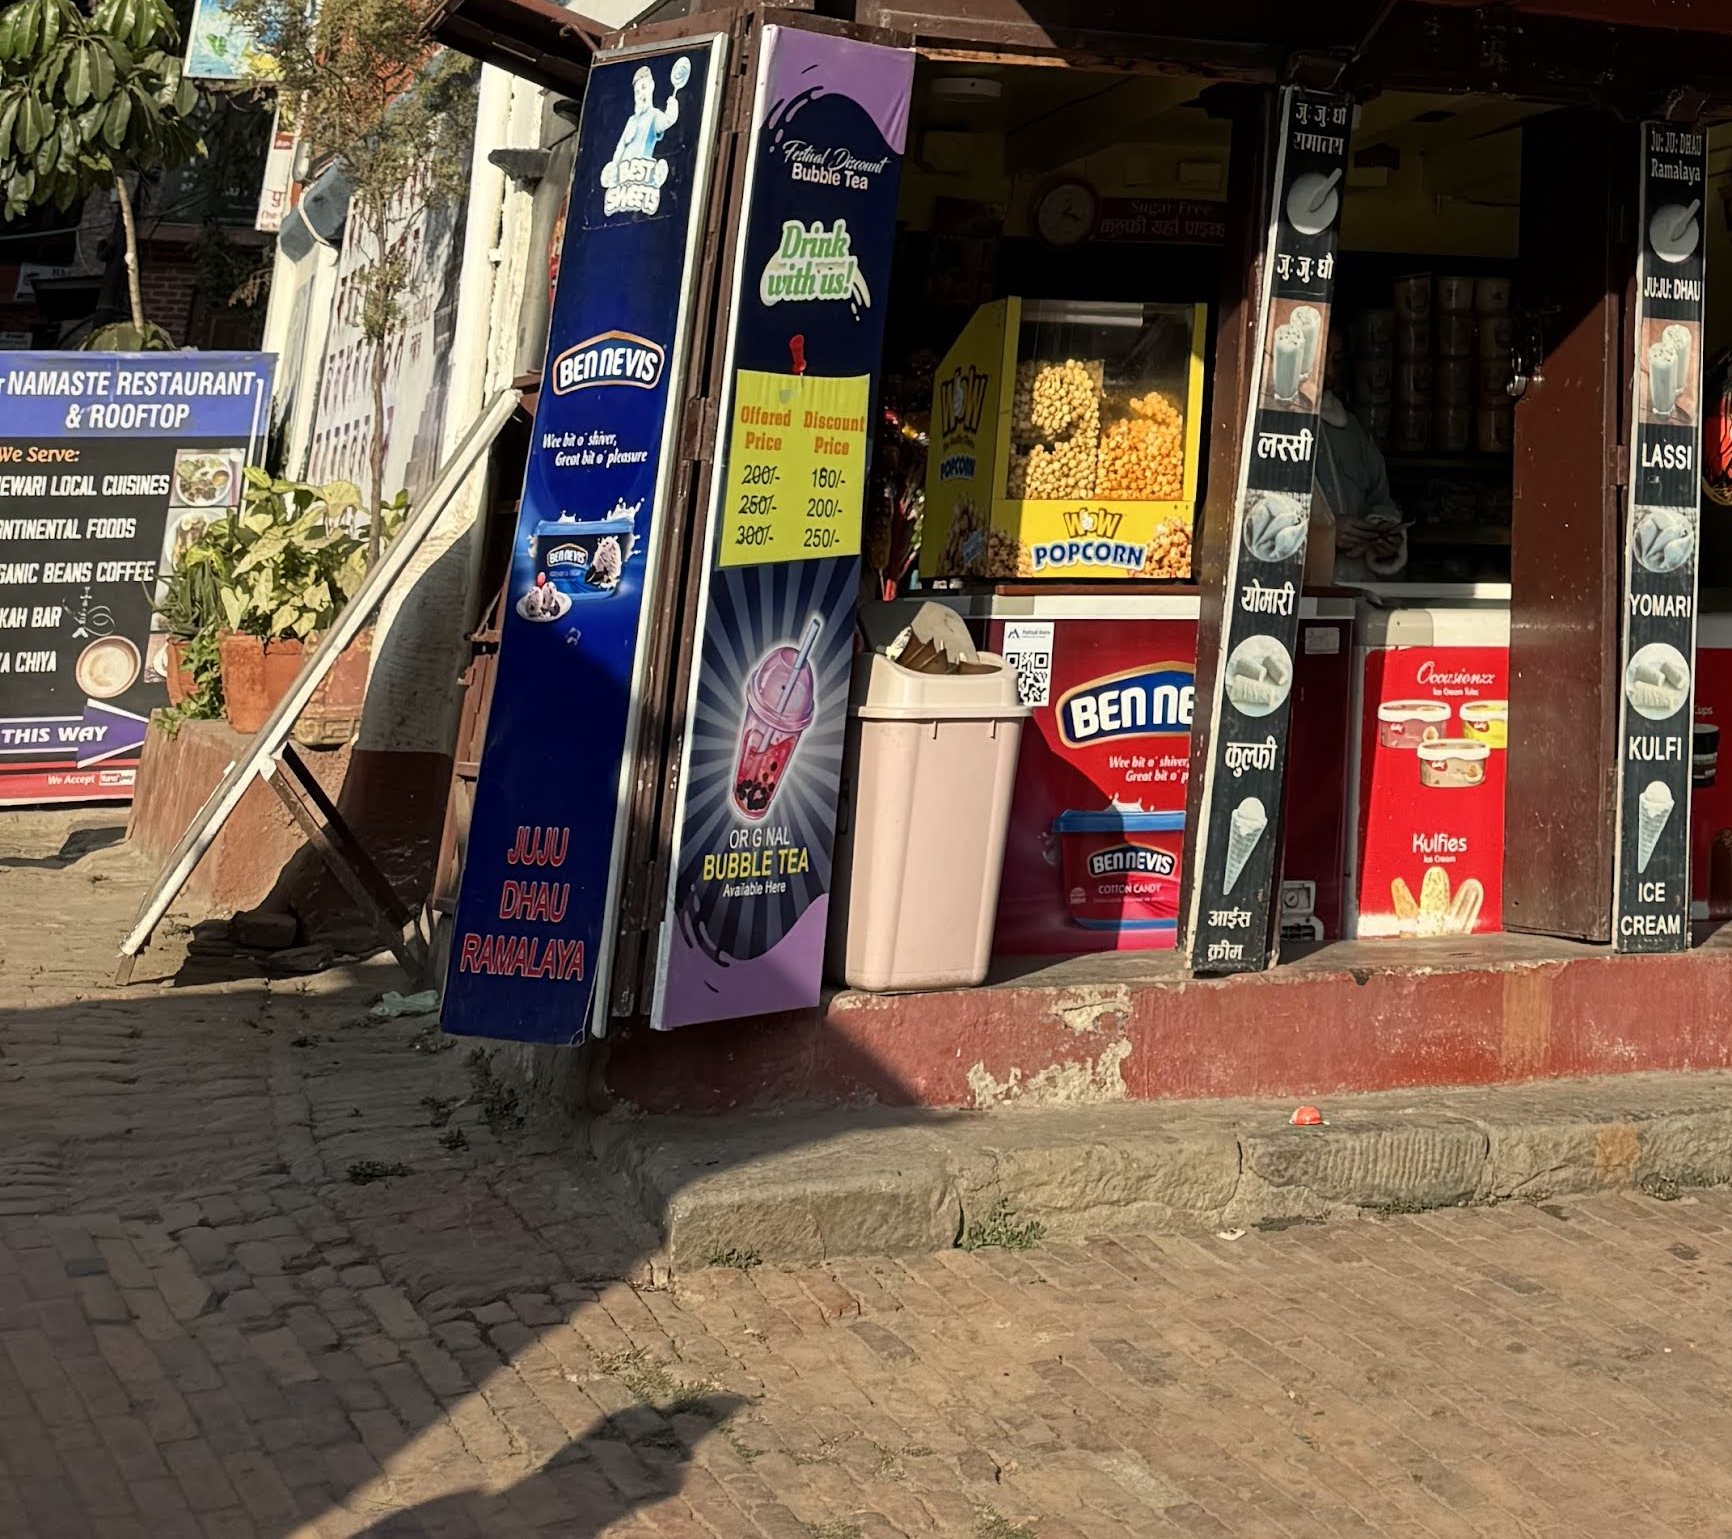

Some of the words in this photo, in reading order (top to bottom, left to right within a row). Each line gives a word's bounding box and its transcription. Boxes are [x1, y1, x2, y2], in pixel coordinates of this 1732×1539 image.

[1680, 133, 1702, 156] DHAU
[782, 140, 830, 165] Festival
[828, 148, 891, 173] Discount
[792, 163, 840, 186] Bubble
[844, 171, 868, 190] Tea
[1651, 158, 1701, 186] Ramalaya
[781, 224, 848, 259] Drink
[768, 261, 816, 296] with
[820, 261, 854, 295] us!
[1674, 279, 1701, 302] DHAU
[560, 353, 602, 393] BEN
[601, 345, 658, 382] NEVIS
[7, 371, 115, 396] NAMASTE
[116, 371, 256, 396] RESTAURANT
[65, 404, 82, 429] &
[88, 403, 190, 429] ROOFTOP
[741, 406, 791, 426] Offered
[804, 411, 865, 432] Discount
[543, 433, 564, 449] Wee
[564, 433, 578, 448] bit
[587, 433, 617, 448] shiver,
[745, 431, 782, 451] Price
[814, 436, 849, 455] Price
[0, 447, 23, 462] We
[26, 446, 80, 462] Serve:
[555, 452, 581, 466] Great
[581, 451, 595, 465] bit
[607, 448, 647, 468] pleasure
[1641, 443, 1692, 471] LASSI
[0, 476, 47, 496] EWARI
[50, 475, 97, 496] LOCAL
[102, 475, 170, 495] CUISINES
[806, 498, 843, 517] 200/-
[0, 519, 82, 539] NTINENTAL
[86, 518, 136, 539] FOODS
[804, 528, 840, 547] 250/-
[1034, 544, 1145, 566] POPCORN
[0, 563, 39, 584] GANIC
[43, 562, 92, 583] BEANS
[96, 561, 156, 582] COFFEE
[1242, 578, 1295, 616] योमारी
[1630, 593, 1691, 618] YOMARI
[0, 607, 28, 628] KAH
[31, 606, 62, 627] BAR
[15, 651, 56, 672] CHIYA
[1417, 661, 1495, 684] Occasionzz
[1070, 687, 1147, 738] BEN
[1, 728, 50, 744] THIS
[58, 726, 108, 742] WAY
[1225, 736, 1277, 777] कुल्फी
[1629, 736, 1682, 762] KULFI
[1109, 756, 1131, 769] Wee
[1132, 756, 1145, 768] bit
[1159, 755, 1190, 769] shiver,
[48, 775, 62, 785] We
[64, 775, 95, 785] Accept
[1126, 770, 1152, 782] Great
[1154, 770, 1168, 782] bit
[507, 826, 569, 867] JUJU
[1413, 833, 1467, 854] Kulfies
[703, 850, 773, 881] BUBBLE
[779, 847, 809, 874] TEA
[1093, 852, 1124, 873] BEN
[1125, 852, 1172, 874] NEVIS
[1424, 855, 1433, 863] Ice
[1434, 854, 1456, 863] Cream
[723, 882, 763, 897] Available
[765, 881, 786, 893] Here
[1098, 882, 1132, 894] COTTON
[1133, 882, 1160, 894] CANDY
[1638, 882, 1665, 903] ICE
[500, 881, 570, 922] DHAU
[1621, 915, 1680, 936] CREAM
[459, 933, 584, 981] RAMALAYA
